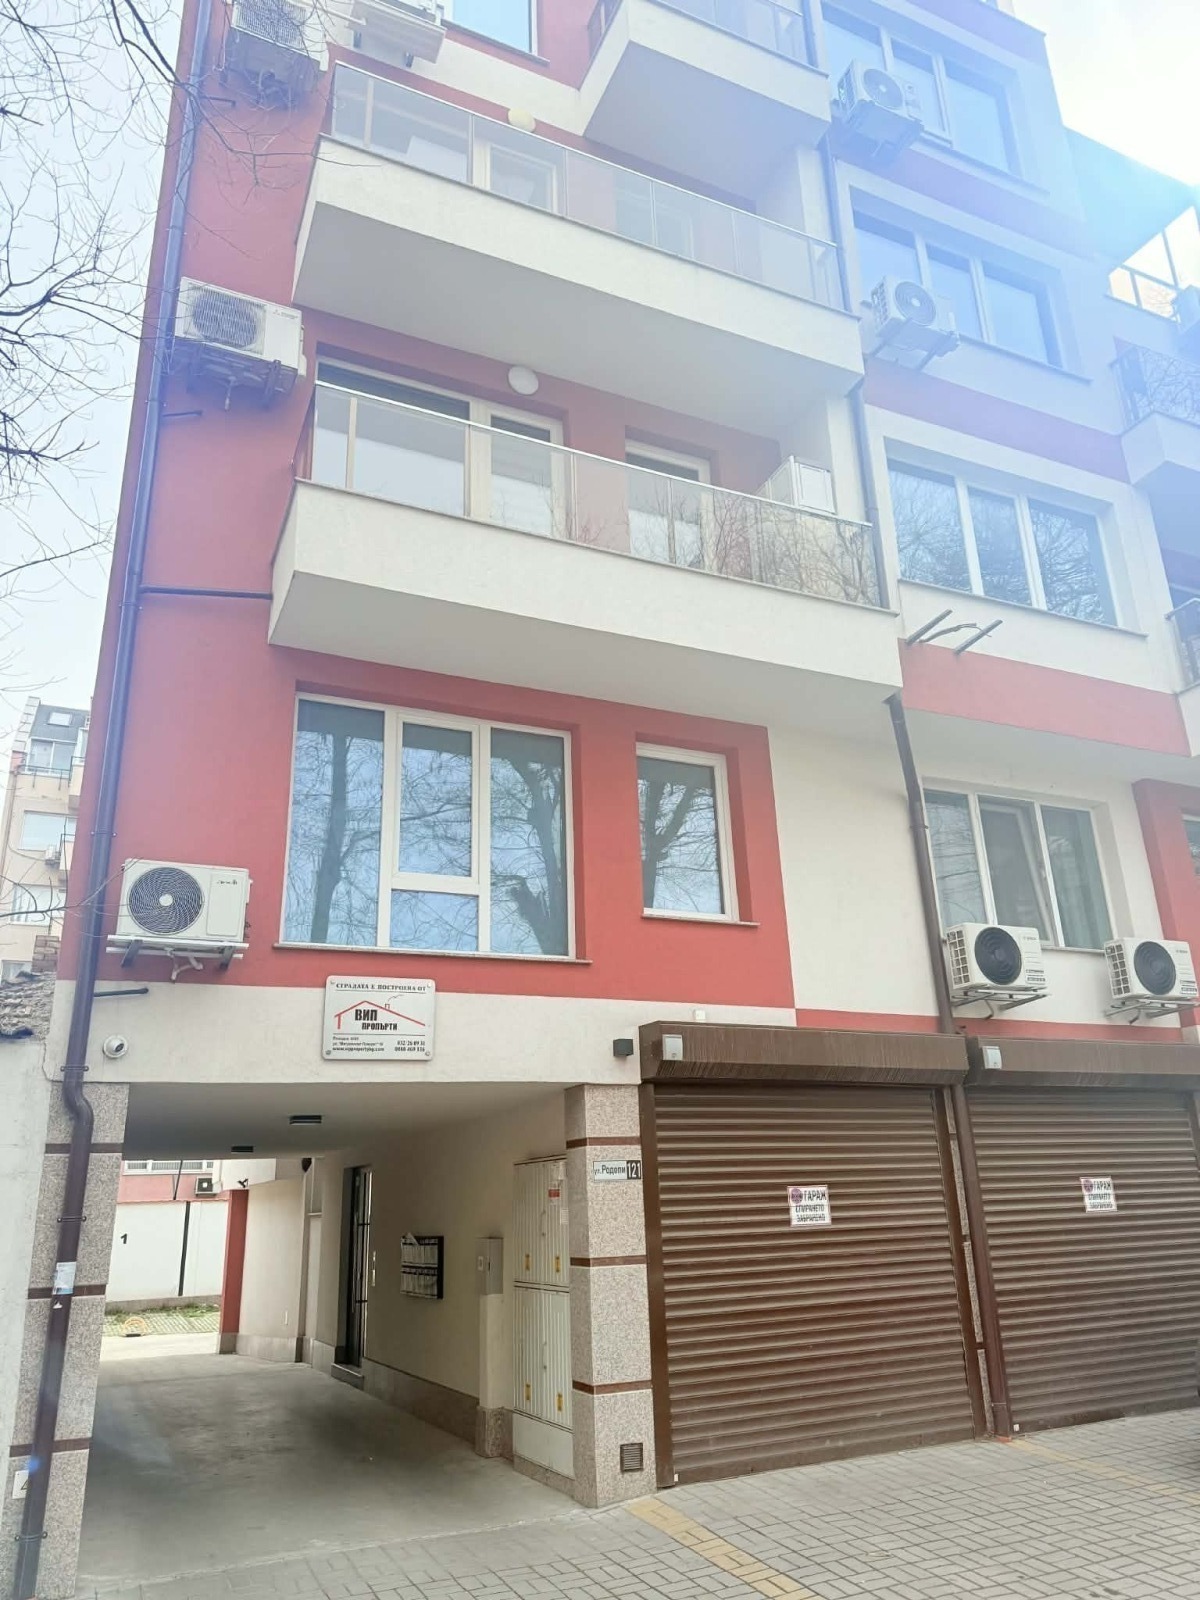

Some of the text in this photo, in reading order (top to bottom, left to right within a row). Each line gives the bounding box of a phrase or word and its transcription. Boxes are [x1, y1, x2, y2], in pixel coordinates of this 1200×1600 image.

[355, 1009, 378, 1021] ВИП
[361, 1022, 398, 1031] ПРОПЪРТИ
[627, 1162, 641, 1178] 121
[1093, 1180, 1111, 1191] ГАРАЖ
[803, 1190, 826, 1202] ГАРАЖ
[120, 1233, 128, 1244] 1
